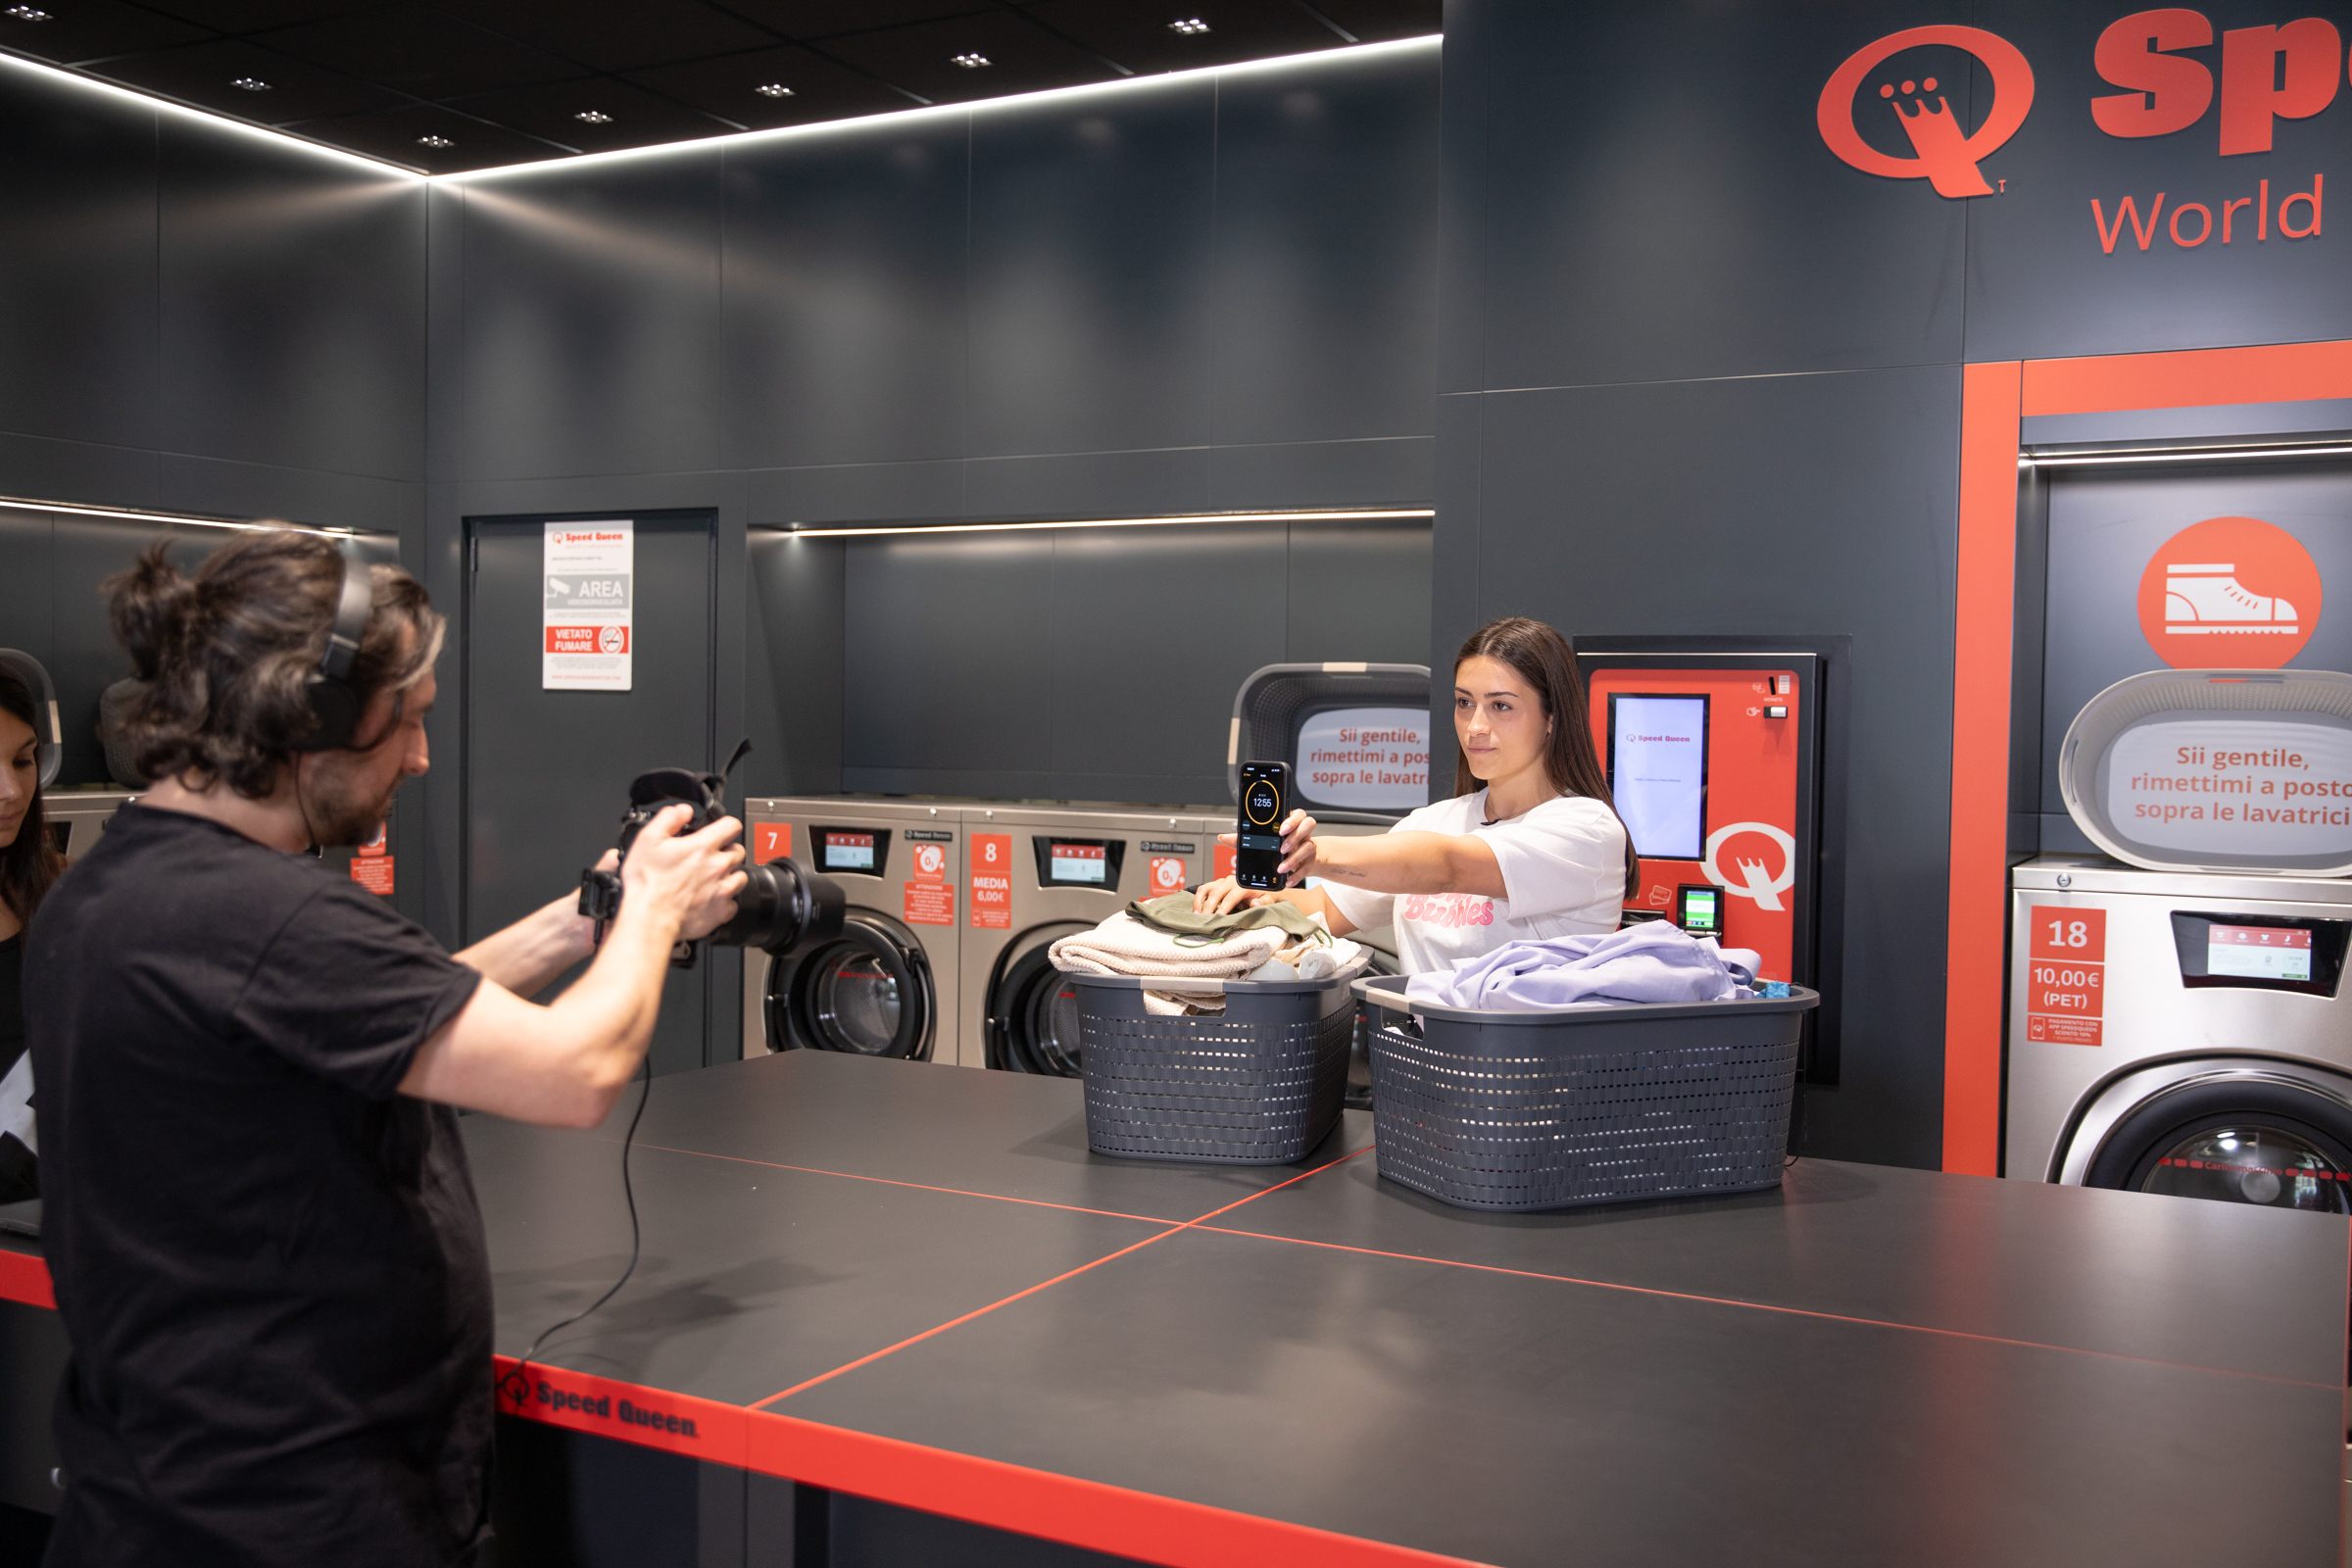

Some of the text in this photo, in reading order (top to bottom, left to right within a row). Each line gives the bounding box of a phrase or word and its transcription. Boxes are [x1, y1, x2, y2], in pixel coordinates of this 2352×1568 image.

[2091, 8, 2352, 157] Sp
[2090, 173, 2324, 254] World
[565, 533, 593, 543] Speed
[596, 531, 623, 541] Queen
[579, 580, 623, 599] AREA
[555, 628, 593, 639] VIETATO
[555, 641, 593, 652] FUMARE
[1339, 728, 1421, 746] Sii gentile,
[1310, 748, 1385, 763] rimettimi
[1390, 752, 1398, 763] a
[2177, 746, 2310, 771] Sii gentile,
[1312, 770, 1354, 788] sopra
[1360, 768, 1373, 785] le
[2131, 772, 2252, 795] rimettimi
[2260, 780, 2275, 795] a
[2134, 801, 2350, 826] sopra le lavatrici
[767, 832, 777, 850] 7
[985, 843, 997, 862] 8
[973, 877, 1008, 890] MEDIA
[977, 891, 1004, 903] 6,00€
[2048, 919, 2087, 948] 18
[2034, 967, 2099, 988] 10,00€
[2043, 991, 2087, 1009] (PET)
[536, 1381, 611, 1418] Speed
[617, 1398, 698, 1438] Queen
